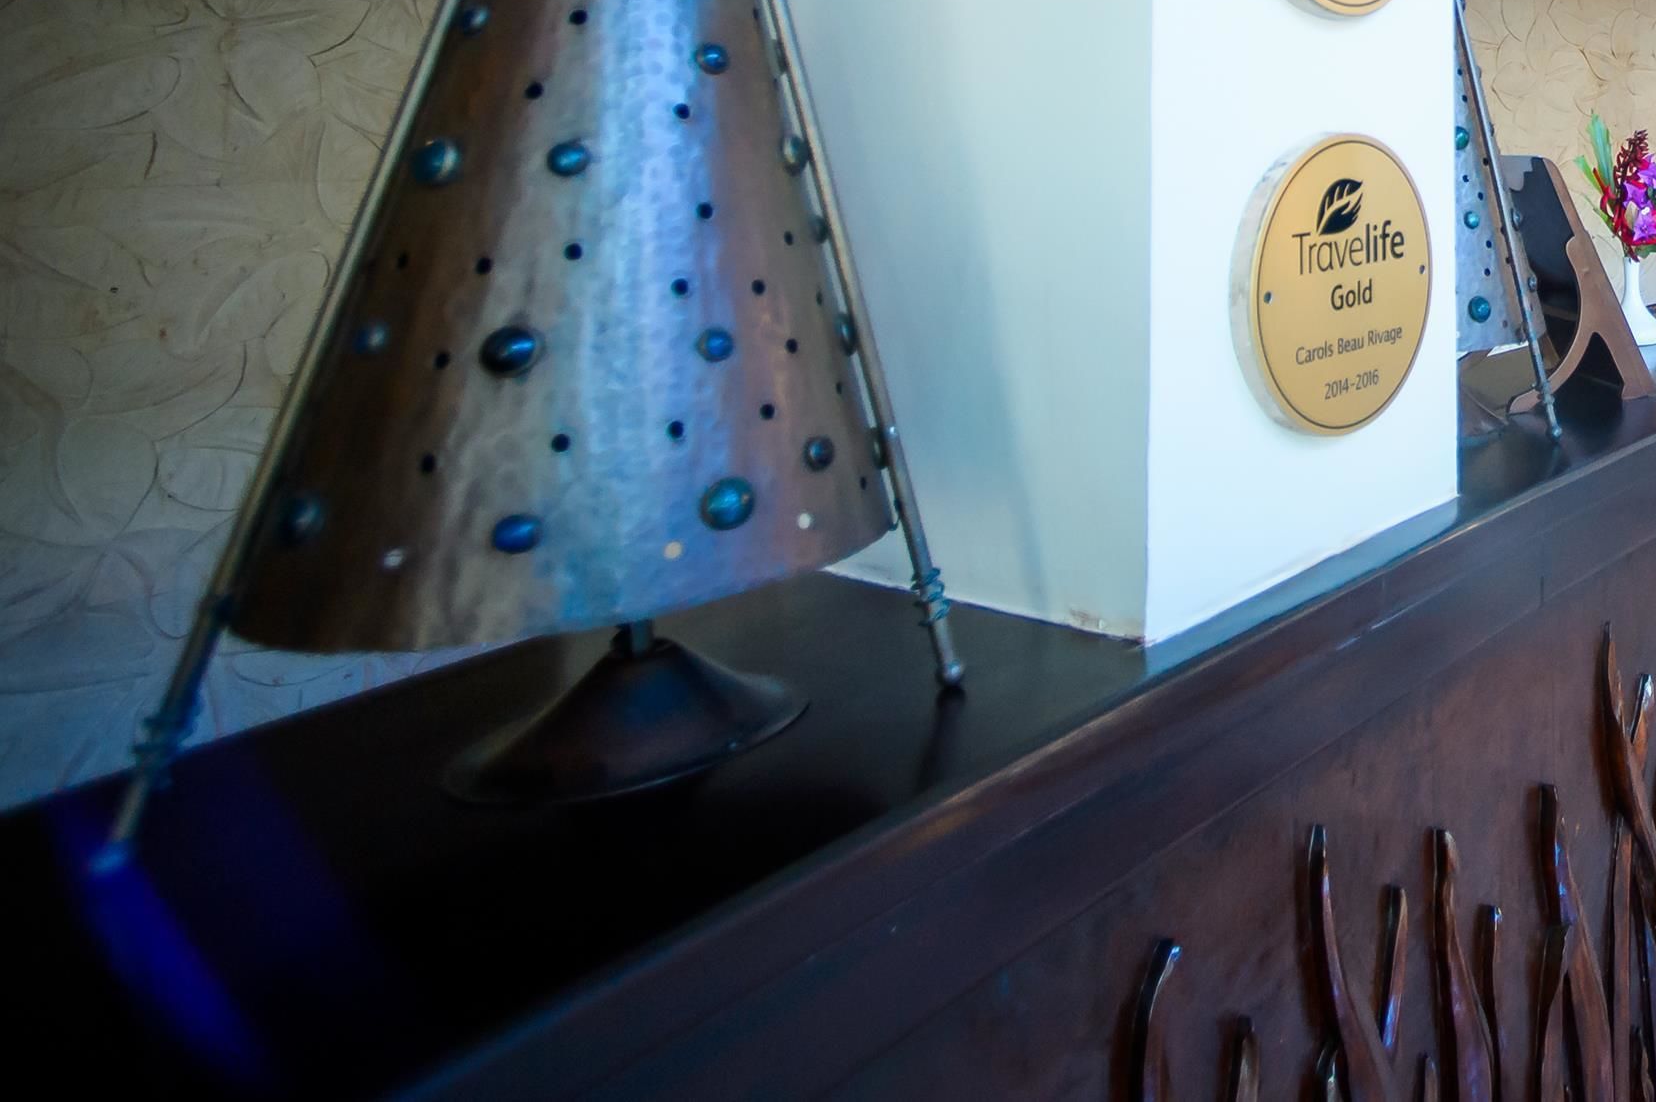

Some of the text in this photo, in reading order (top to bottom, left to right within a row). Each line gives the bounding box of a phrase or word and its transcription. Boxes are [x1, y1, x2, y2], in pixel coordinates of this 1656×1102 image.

[1292, 220, 1405, 276] Travelife
[1331, 279, 1373, 311] Gold
[1295, 326, 1403, 365] Carols Beau Rivage
[1324, 369, 1380, 400] 2014-2016
